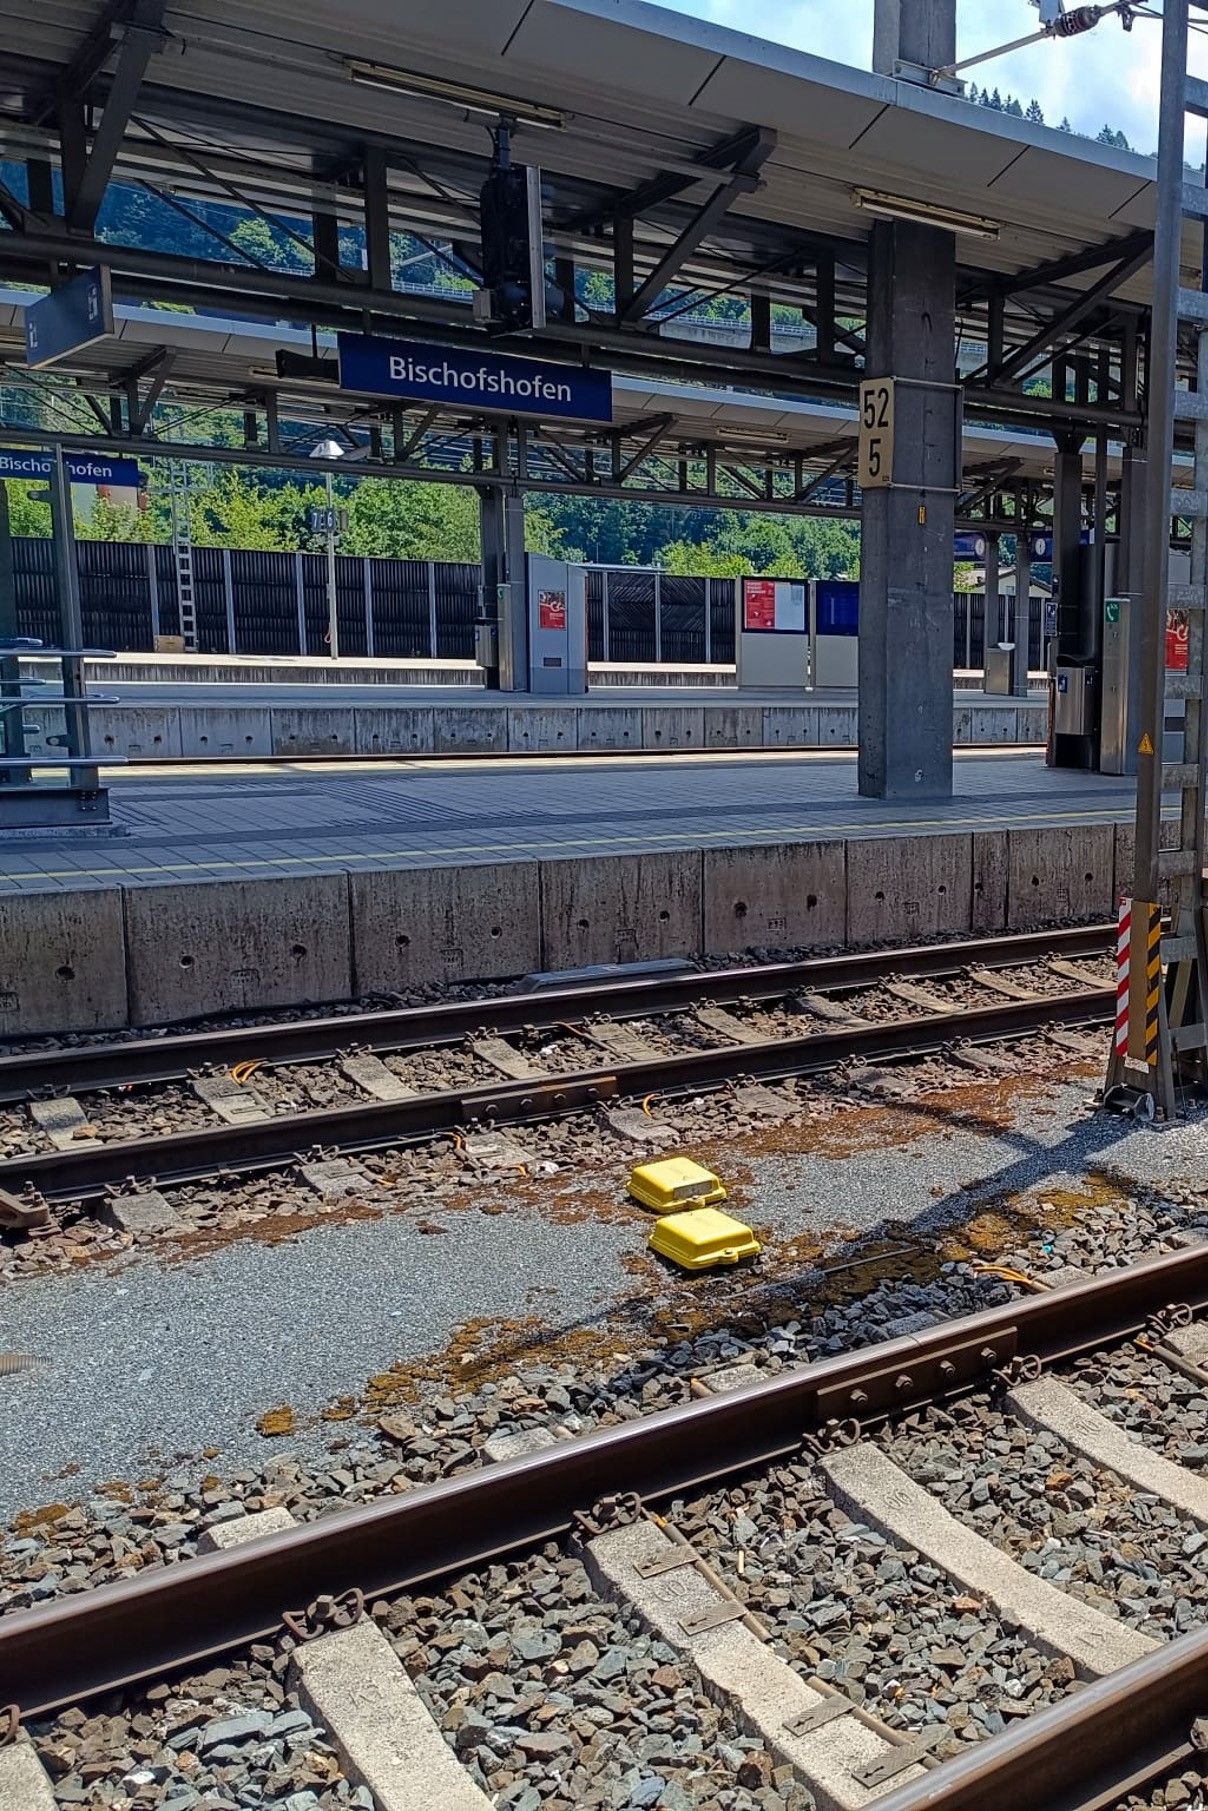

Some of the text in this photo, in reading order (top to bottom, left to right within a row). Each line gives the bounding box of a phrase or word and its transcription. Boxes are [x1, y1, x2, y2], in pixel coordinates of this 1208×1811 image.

[389, 356, 571, 401] Bischofshofen
[864, 388, 889, 429] 52
[0, 456, 112, 477] Bischohofen
[869, 438, 881, 477] 5
